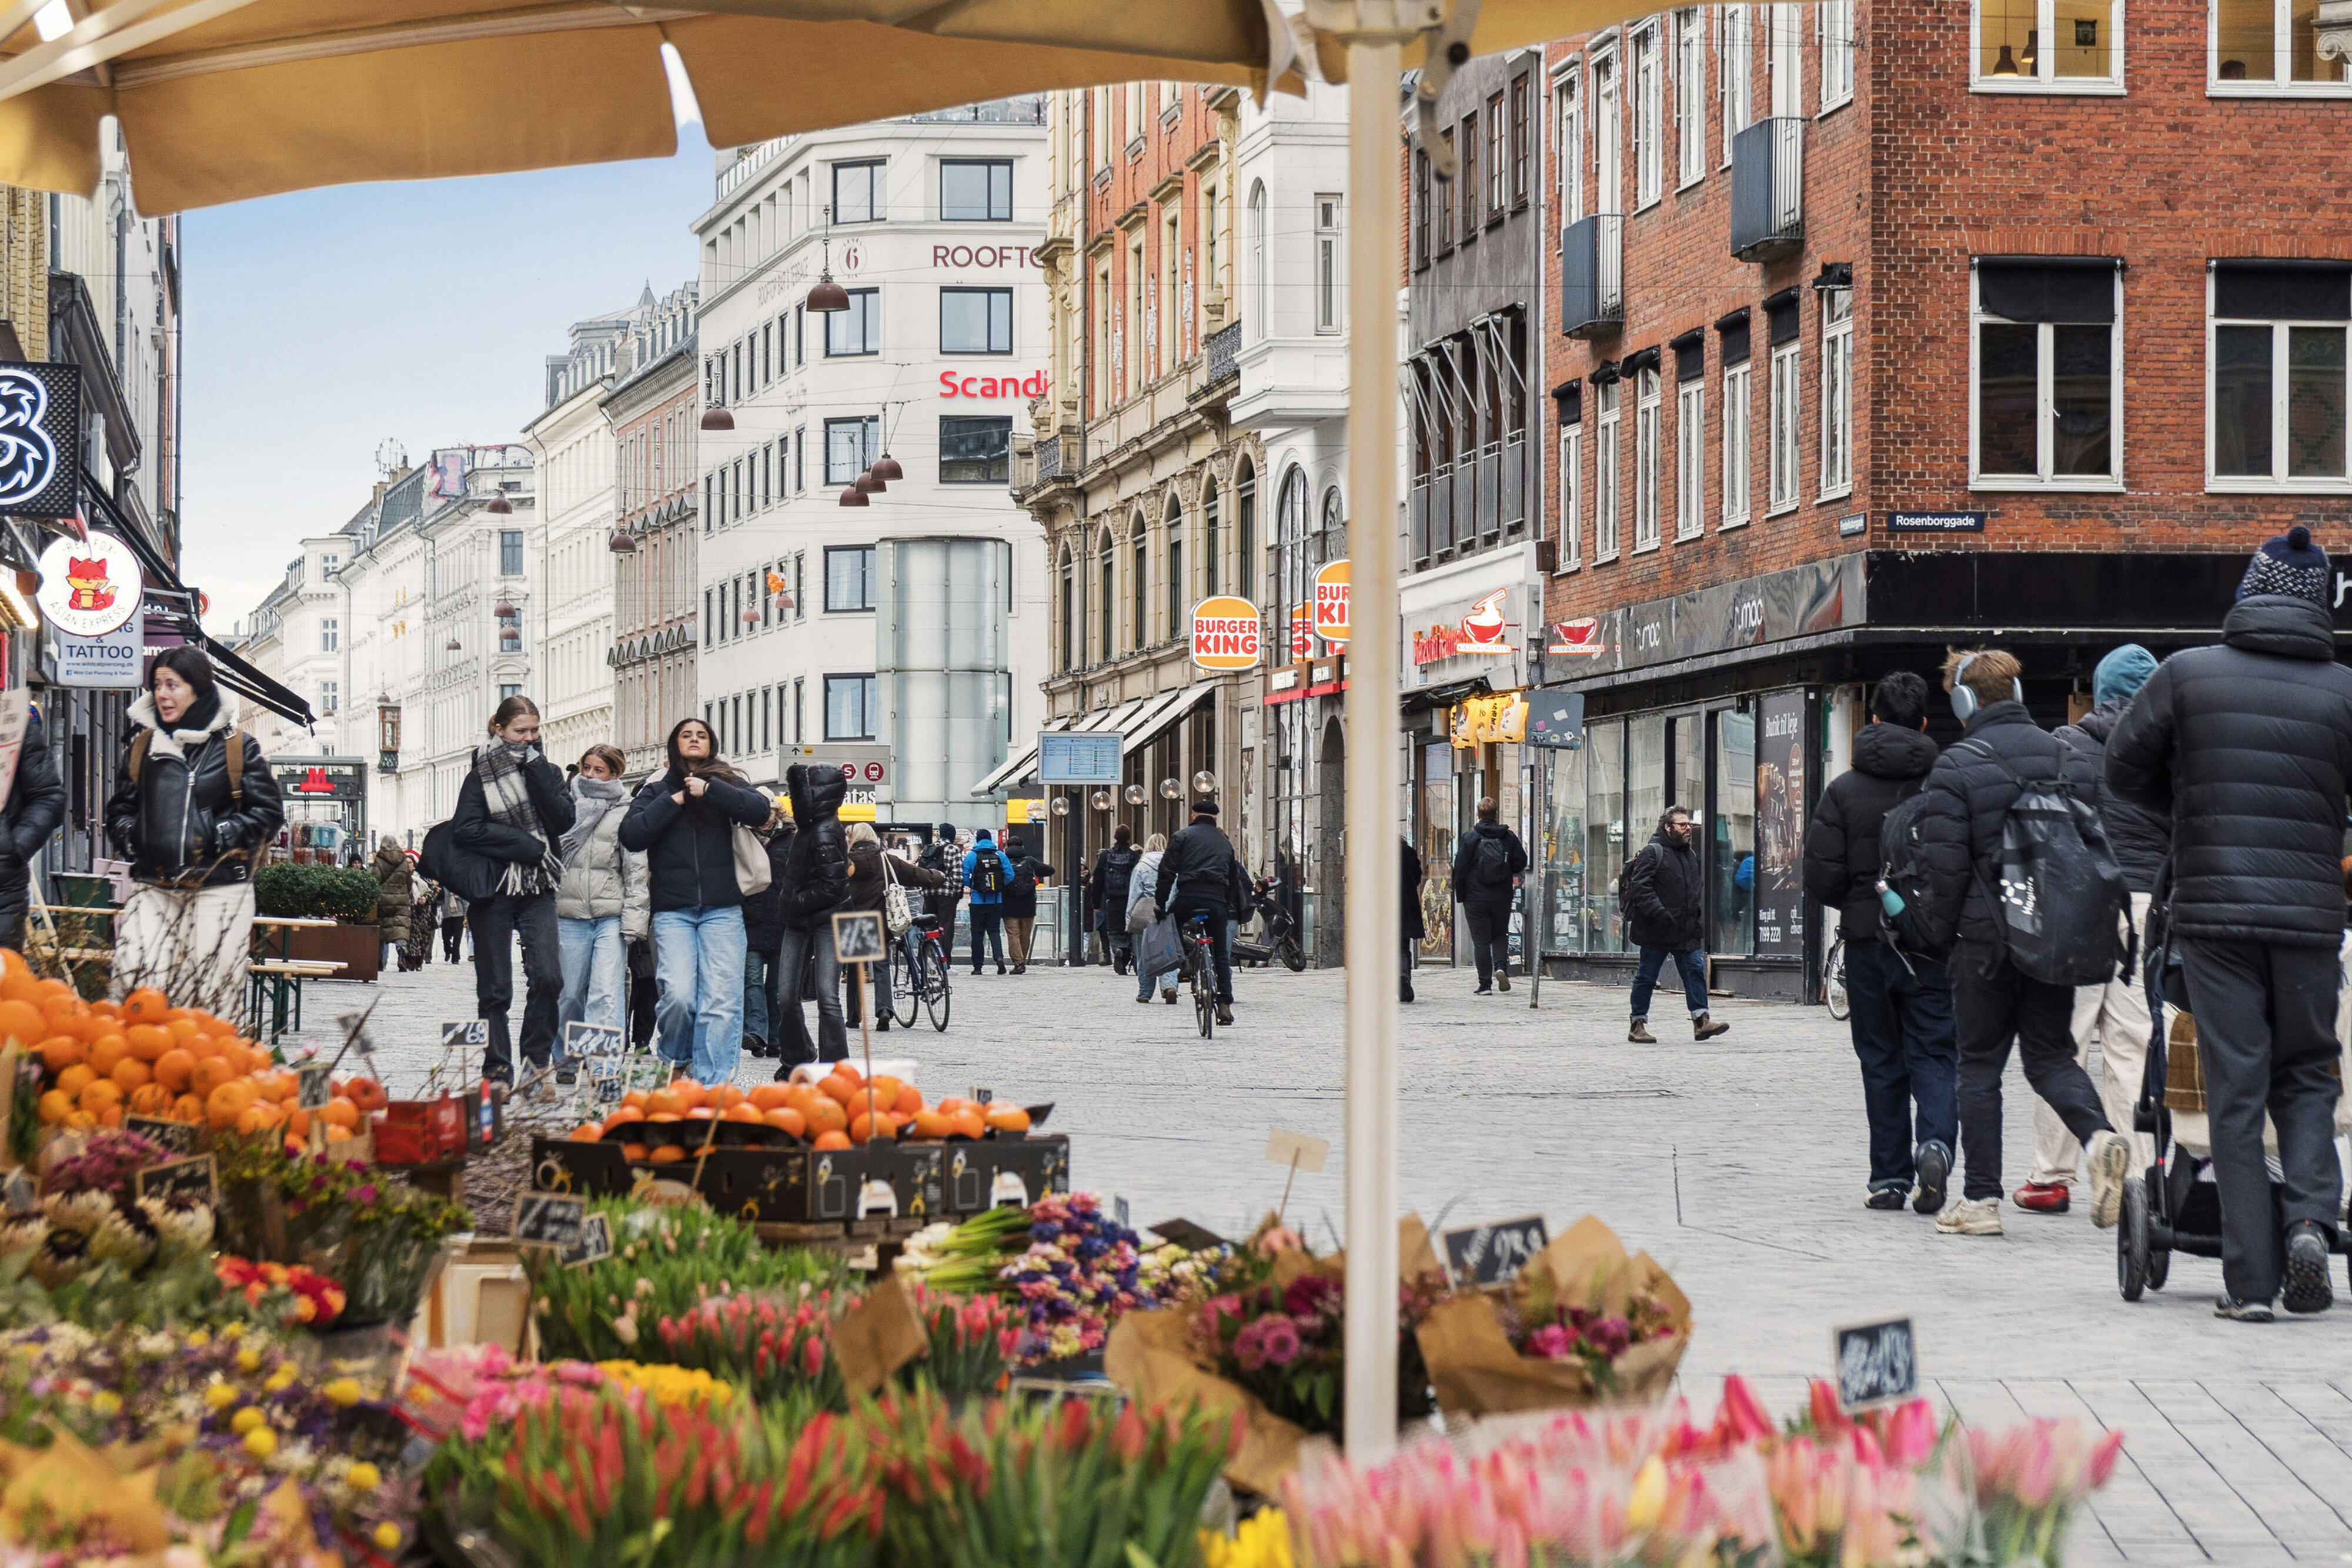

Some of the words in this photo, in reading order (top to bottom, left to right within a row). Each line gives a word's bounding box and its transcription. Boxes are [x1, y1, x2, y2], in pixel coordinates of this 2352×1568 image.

[846, 247, 858, 270] 6
[1896, 515, 1975, 528] Rosenborggade
[50, 601, 77, 626] ASIAN
[82, 604, 126, 628] EXPRESS
[1318, 602, 1348, 624] KI
[1195, 620, 1257, 633] BURGER
[66, 645, 133, 658] TATTOO
[1195, 634, 1257, 654] KING
[1765, 714, 1780, 737] Butik
